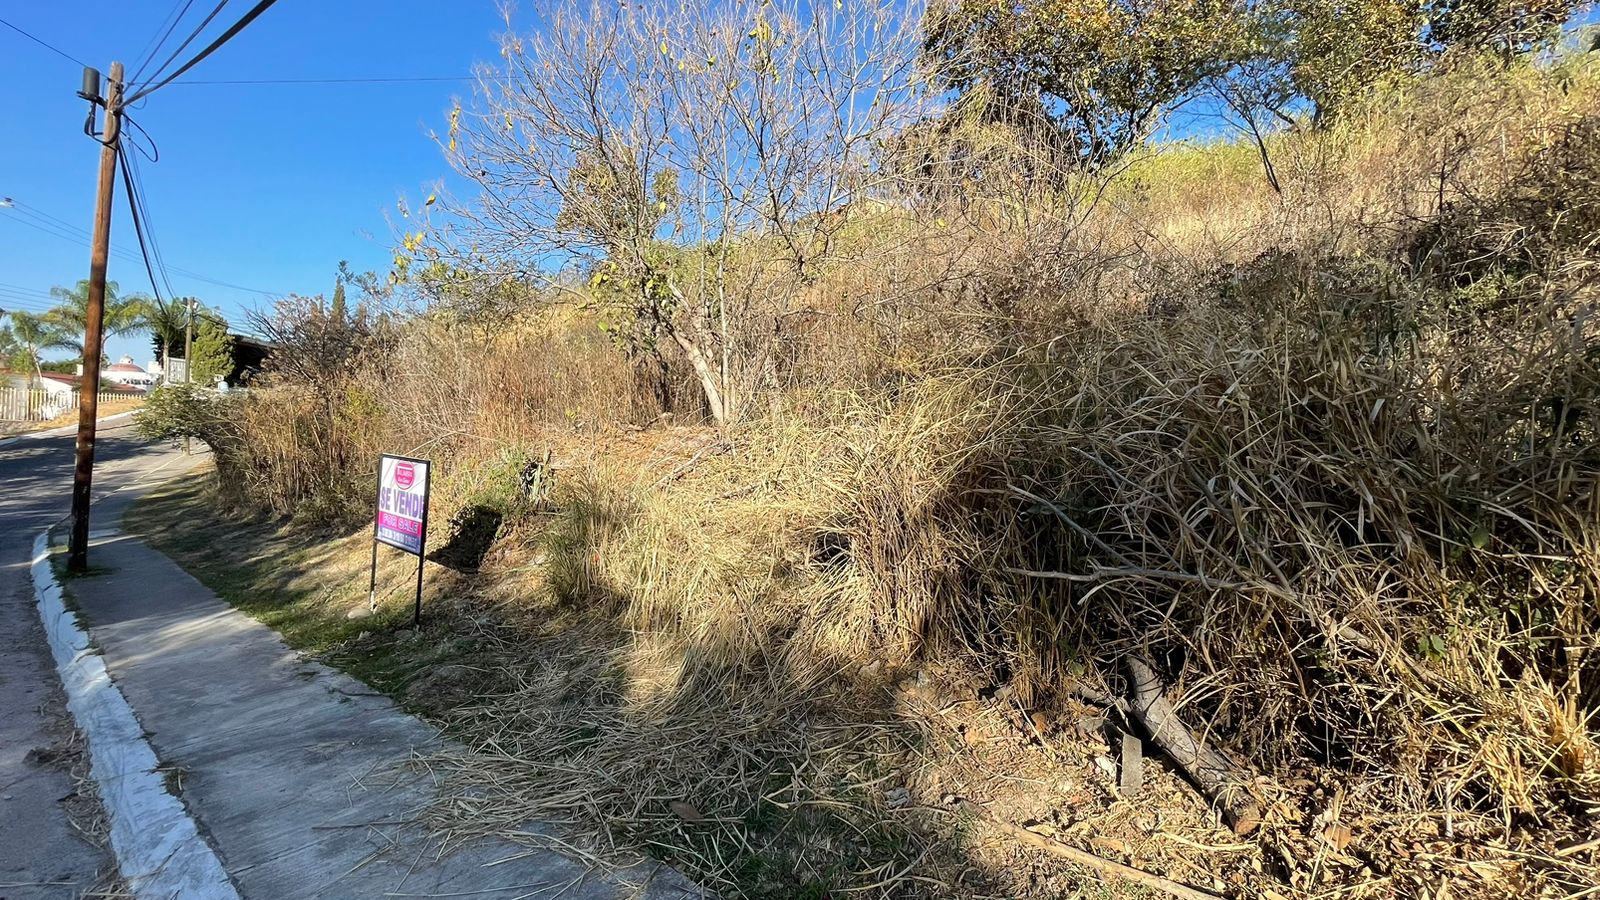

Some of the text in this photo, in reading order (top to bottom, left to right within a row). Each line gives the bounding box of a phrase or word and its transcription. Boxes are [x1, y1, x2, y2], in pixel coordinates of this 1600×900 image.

[381, 486, 391, 511] SE
[383, 513, 418, 533] FOR SALE
